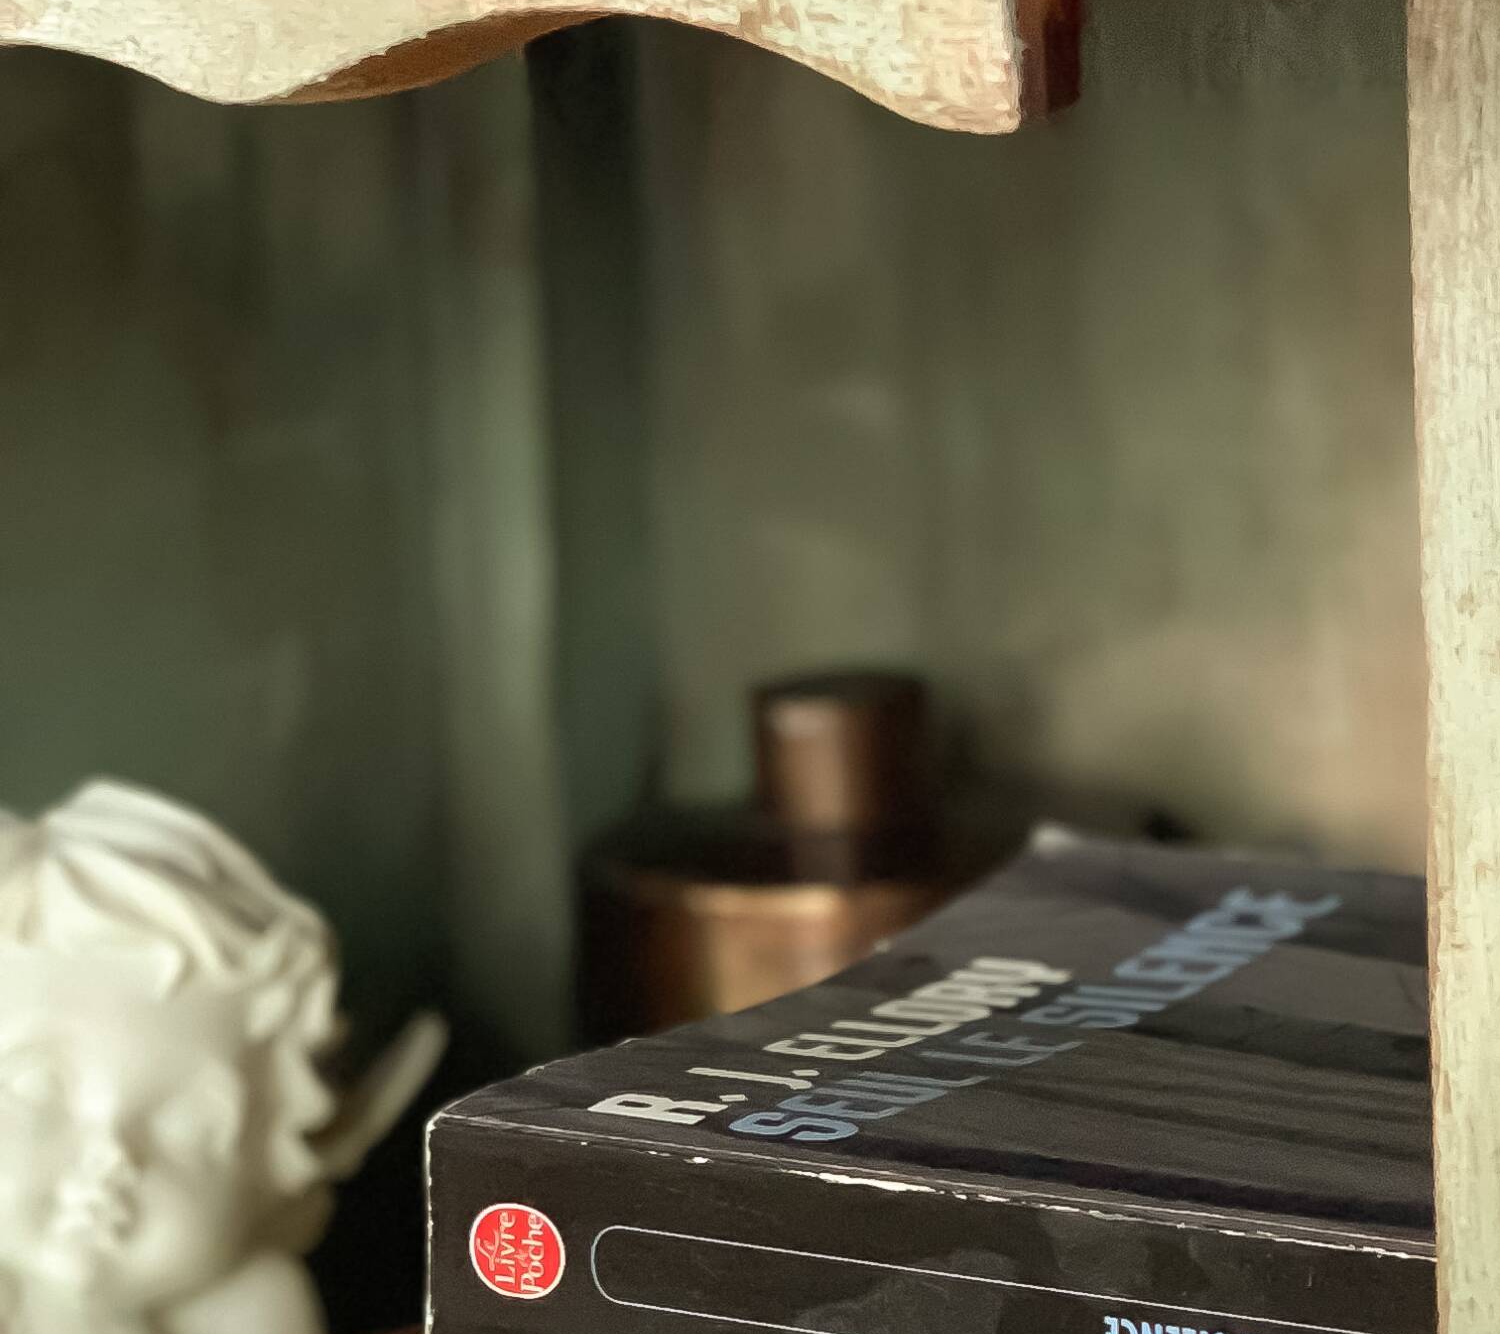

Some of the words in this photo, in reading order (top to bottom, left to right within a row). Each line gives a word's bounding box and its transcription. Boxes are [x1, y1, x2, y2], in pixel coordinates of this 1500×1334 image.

[587, 1093, 748, 1126] R.
[685, 1067, 820, 1090] J.
[728, 1070, 991, 1142] SEUL
[918, 1032, 1086, 1066] LE
[494, 1210, 516, 1285] Livre
[520, 1212, 545, 1293] Poche
